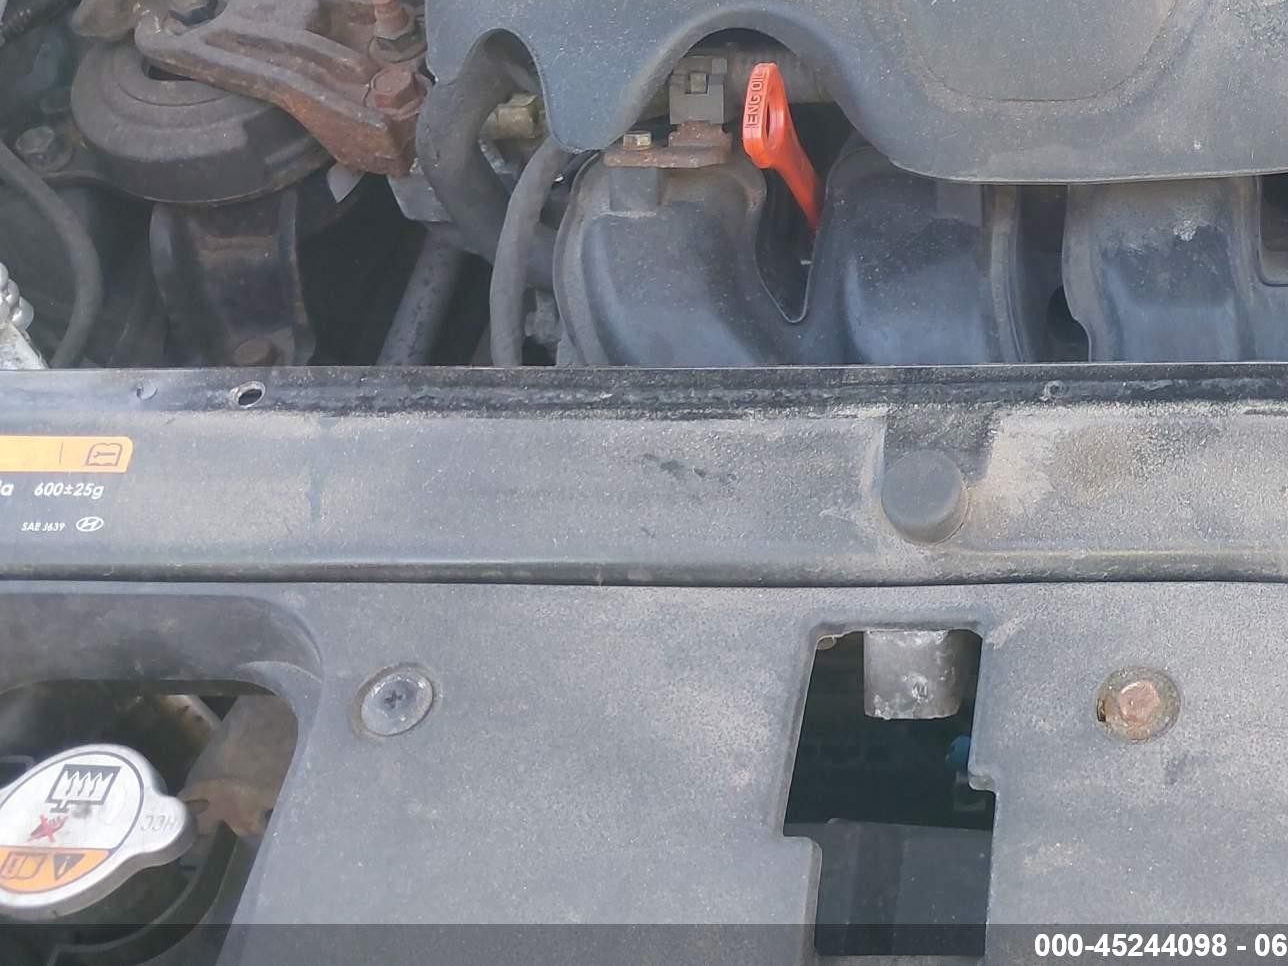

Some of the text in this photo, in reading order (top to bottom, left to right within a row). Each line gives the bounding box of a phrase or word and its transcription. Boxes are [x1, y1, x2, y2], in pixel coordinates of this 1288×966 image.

[747, 73, 766, 124] ENG OIL
[33, 482, 105, 500] 600±25g
[21, 521, 66, 532] SAE J639
